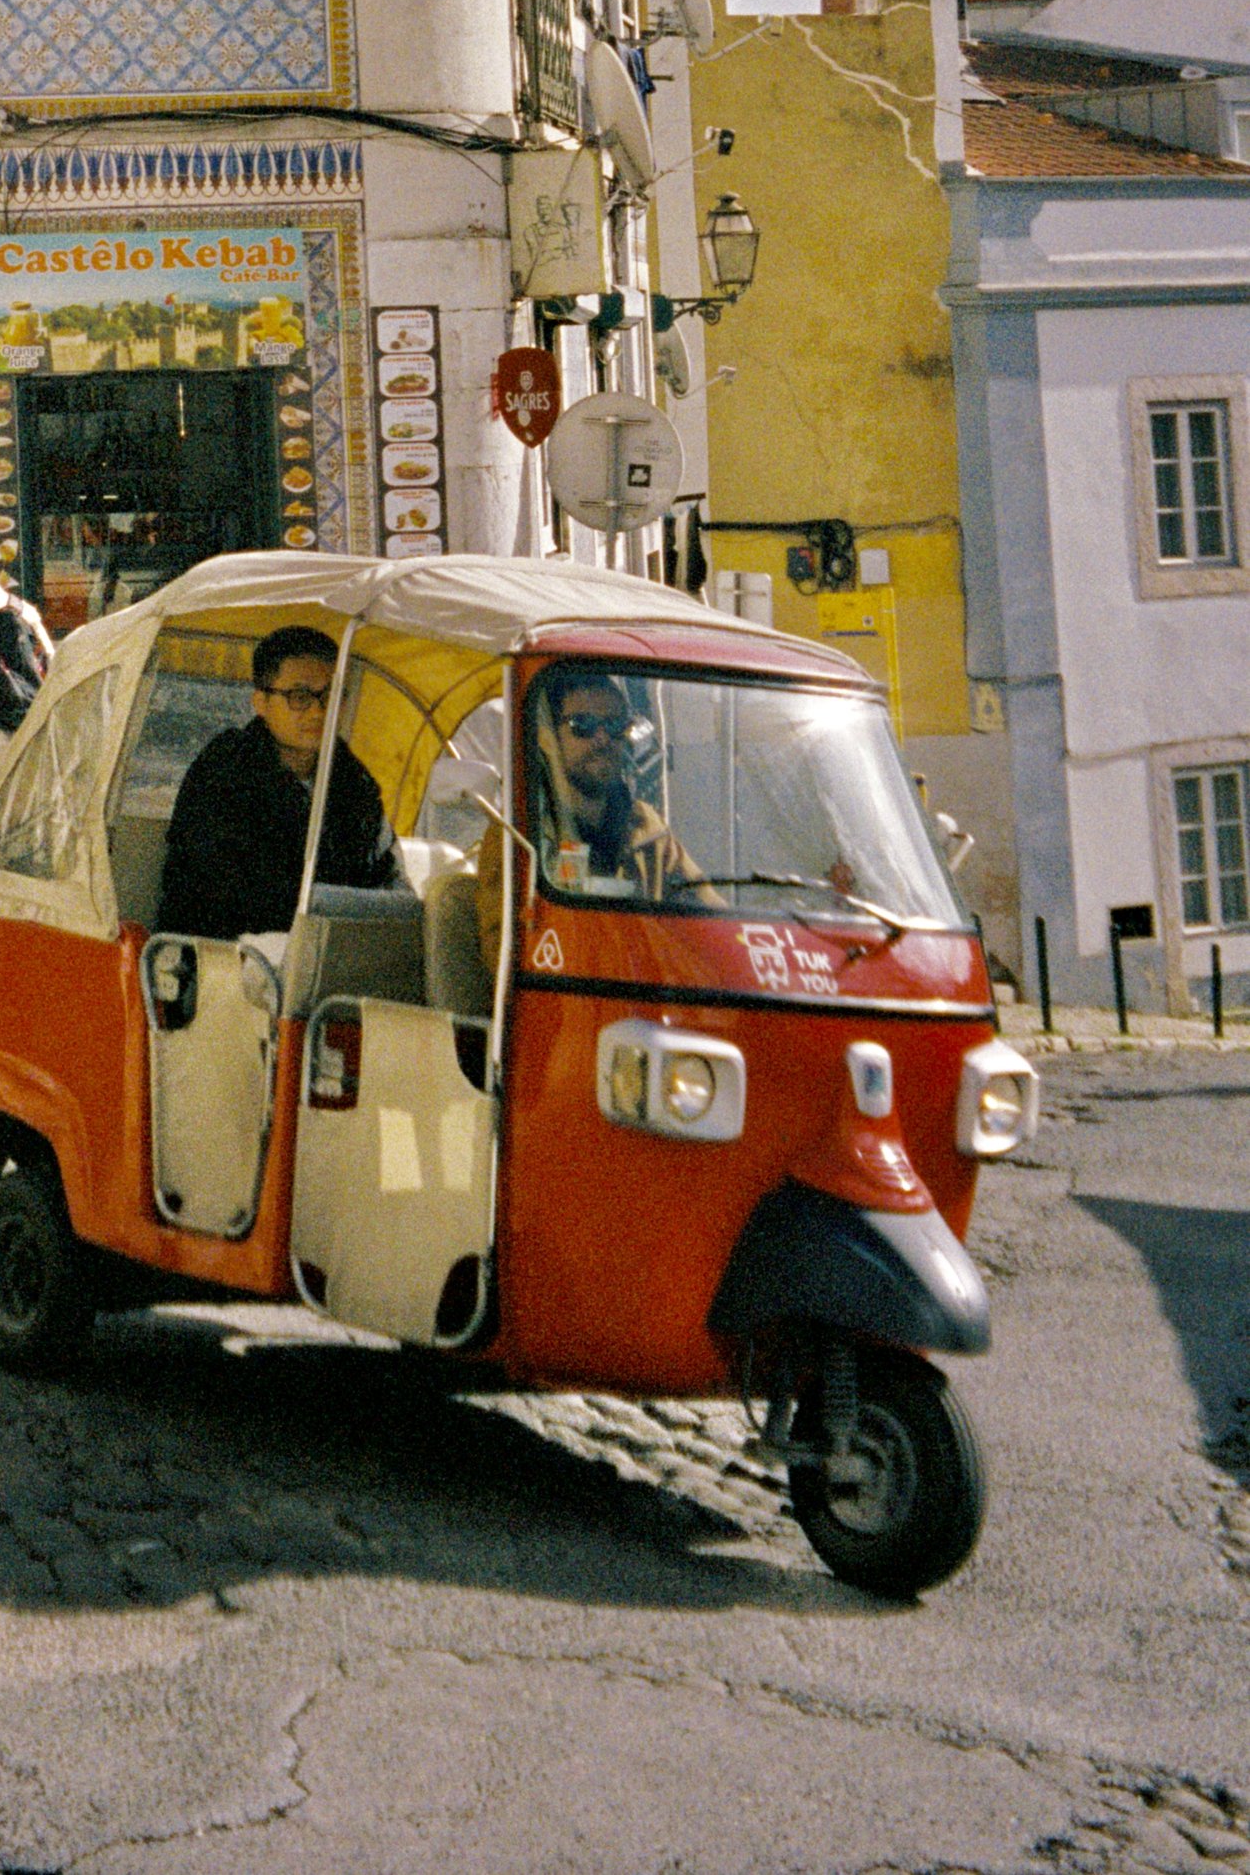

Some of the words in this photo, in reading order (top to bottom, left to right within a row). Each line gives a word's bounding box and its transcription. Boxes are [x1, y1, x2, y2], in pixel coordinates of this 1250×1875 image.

[160, 236, 298, 269] Kebab
[220, 268, 301, 283] Café-Bar
[1, 345, 44, 358] Orange
[255, 341, 295, 354] Mango
[9, 356, 38, 367] Juice
[505, 391, 551, 413] SAGRES
[785, 927, 795, 947] I
[792, 949, 833, 973] TUK
[797, 972, 839, 995] YOU
